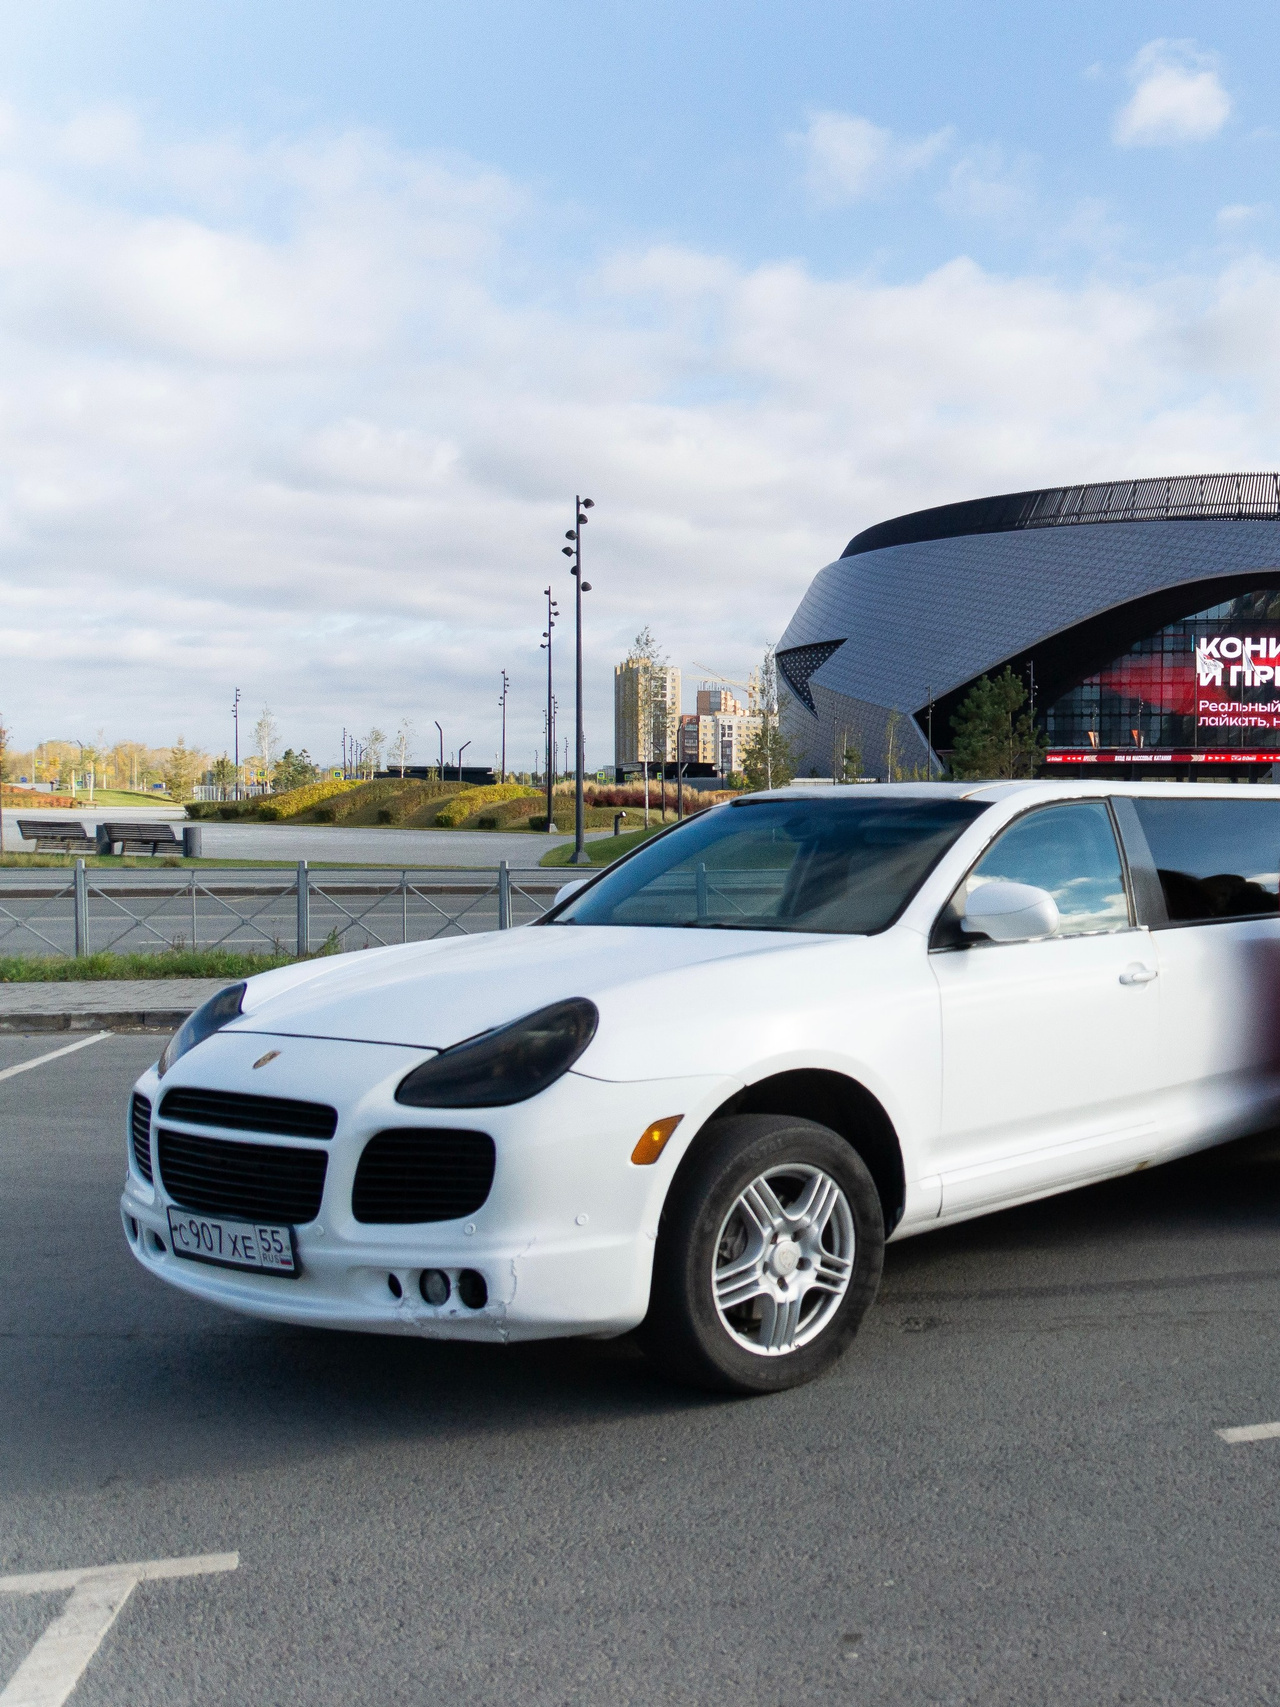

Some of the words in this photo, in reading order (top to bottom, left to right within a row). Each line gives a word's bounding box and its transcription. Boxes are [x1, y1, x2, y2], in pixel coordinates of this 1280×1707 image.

[1199, 700, 1280, 713] Реальный
[1198, 714, 1270, 728] лайкать,
[258, 1228, 284, 1253] 55
[262, 1252, 280, 1264] RUS
